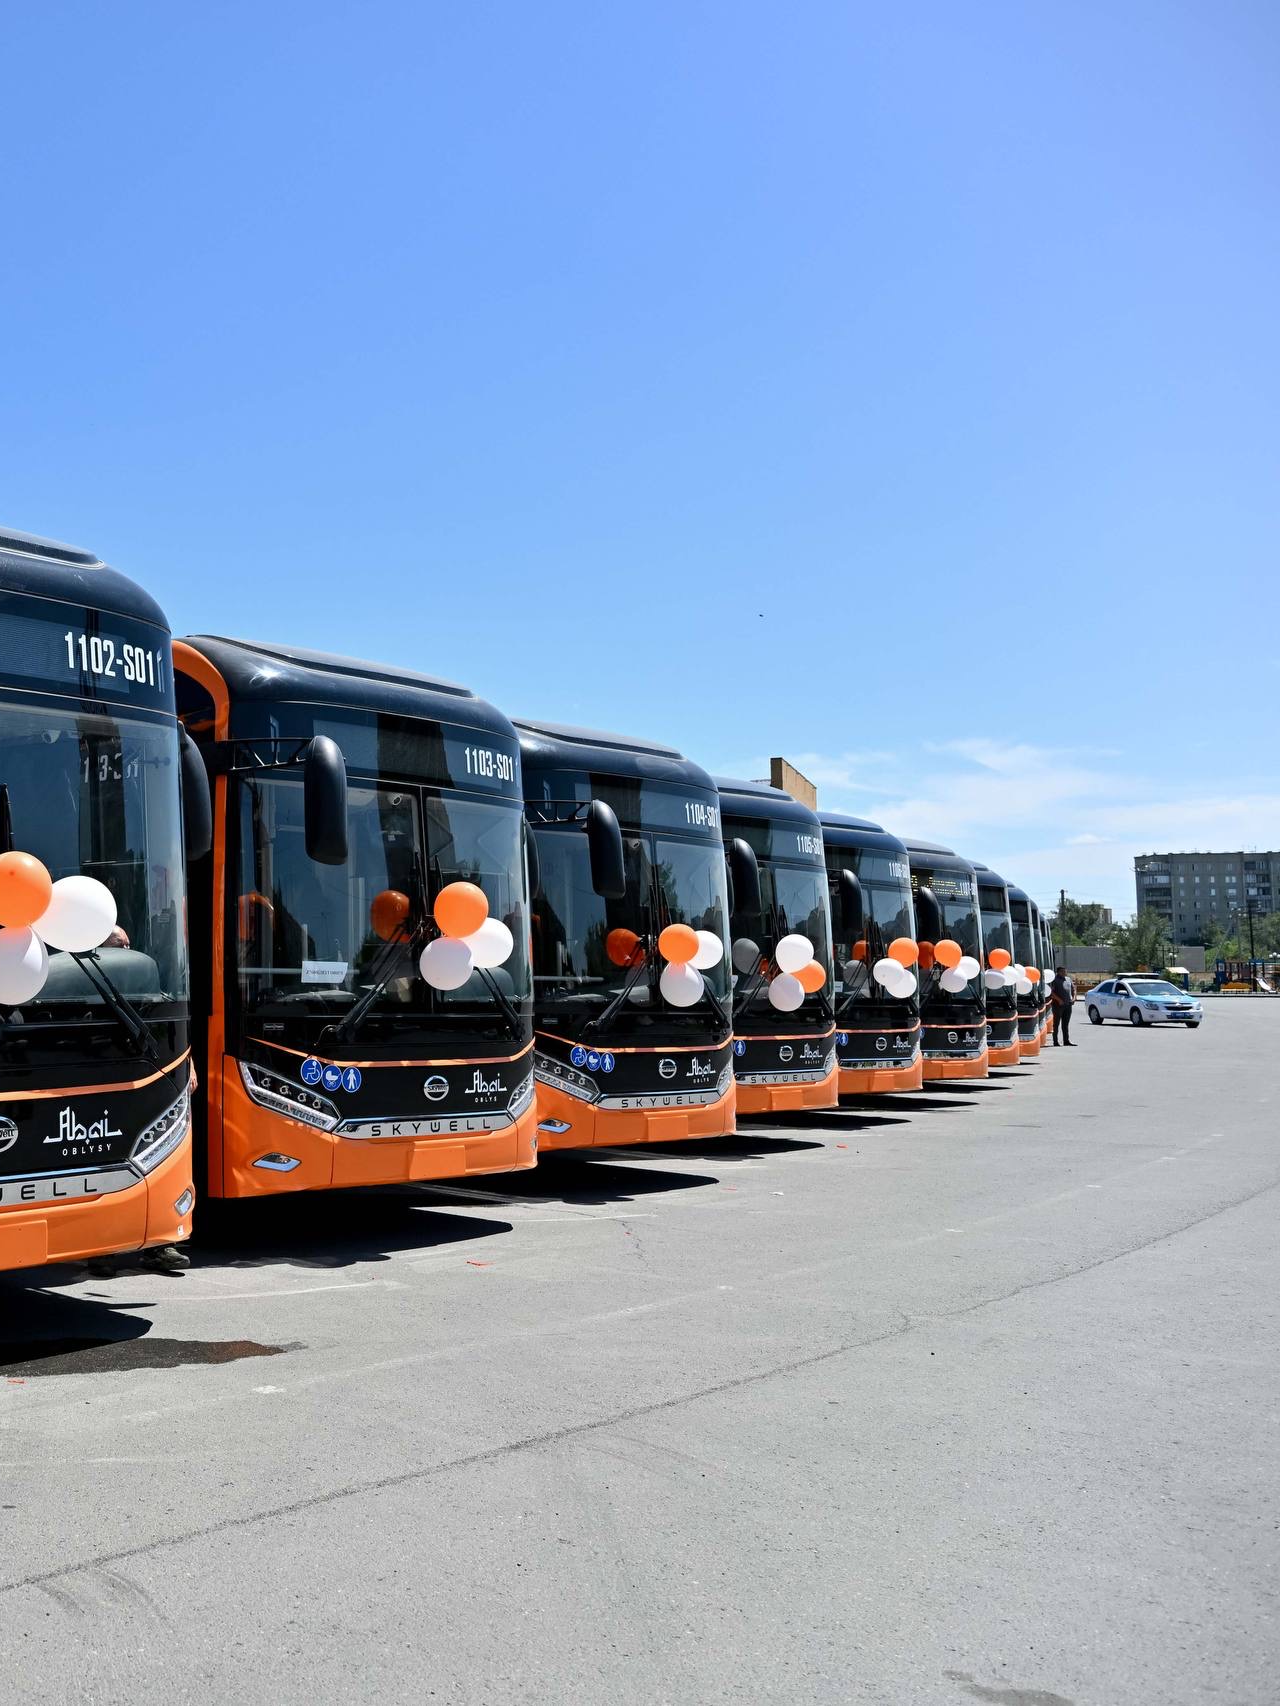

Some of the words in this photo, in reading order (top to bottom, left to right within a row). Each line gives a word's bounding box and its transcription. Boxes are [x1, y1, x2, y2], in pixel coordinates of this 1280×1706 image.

[64, 631, 154, 687] 1102-S01
[465, 747, 514, 782] 1103-S01
[465, 1069, 507, 1096] Abai
[751, 1074, 816, 1084] SKYWELL
[621, 1095, 706, 1108] SKYWELL
[43, 1106, 123, 1145] Abai
[371, 1118, 491, 1137] SKYWELL
[62, 1143, 112, 1156] OBLYSY
